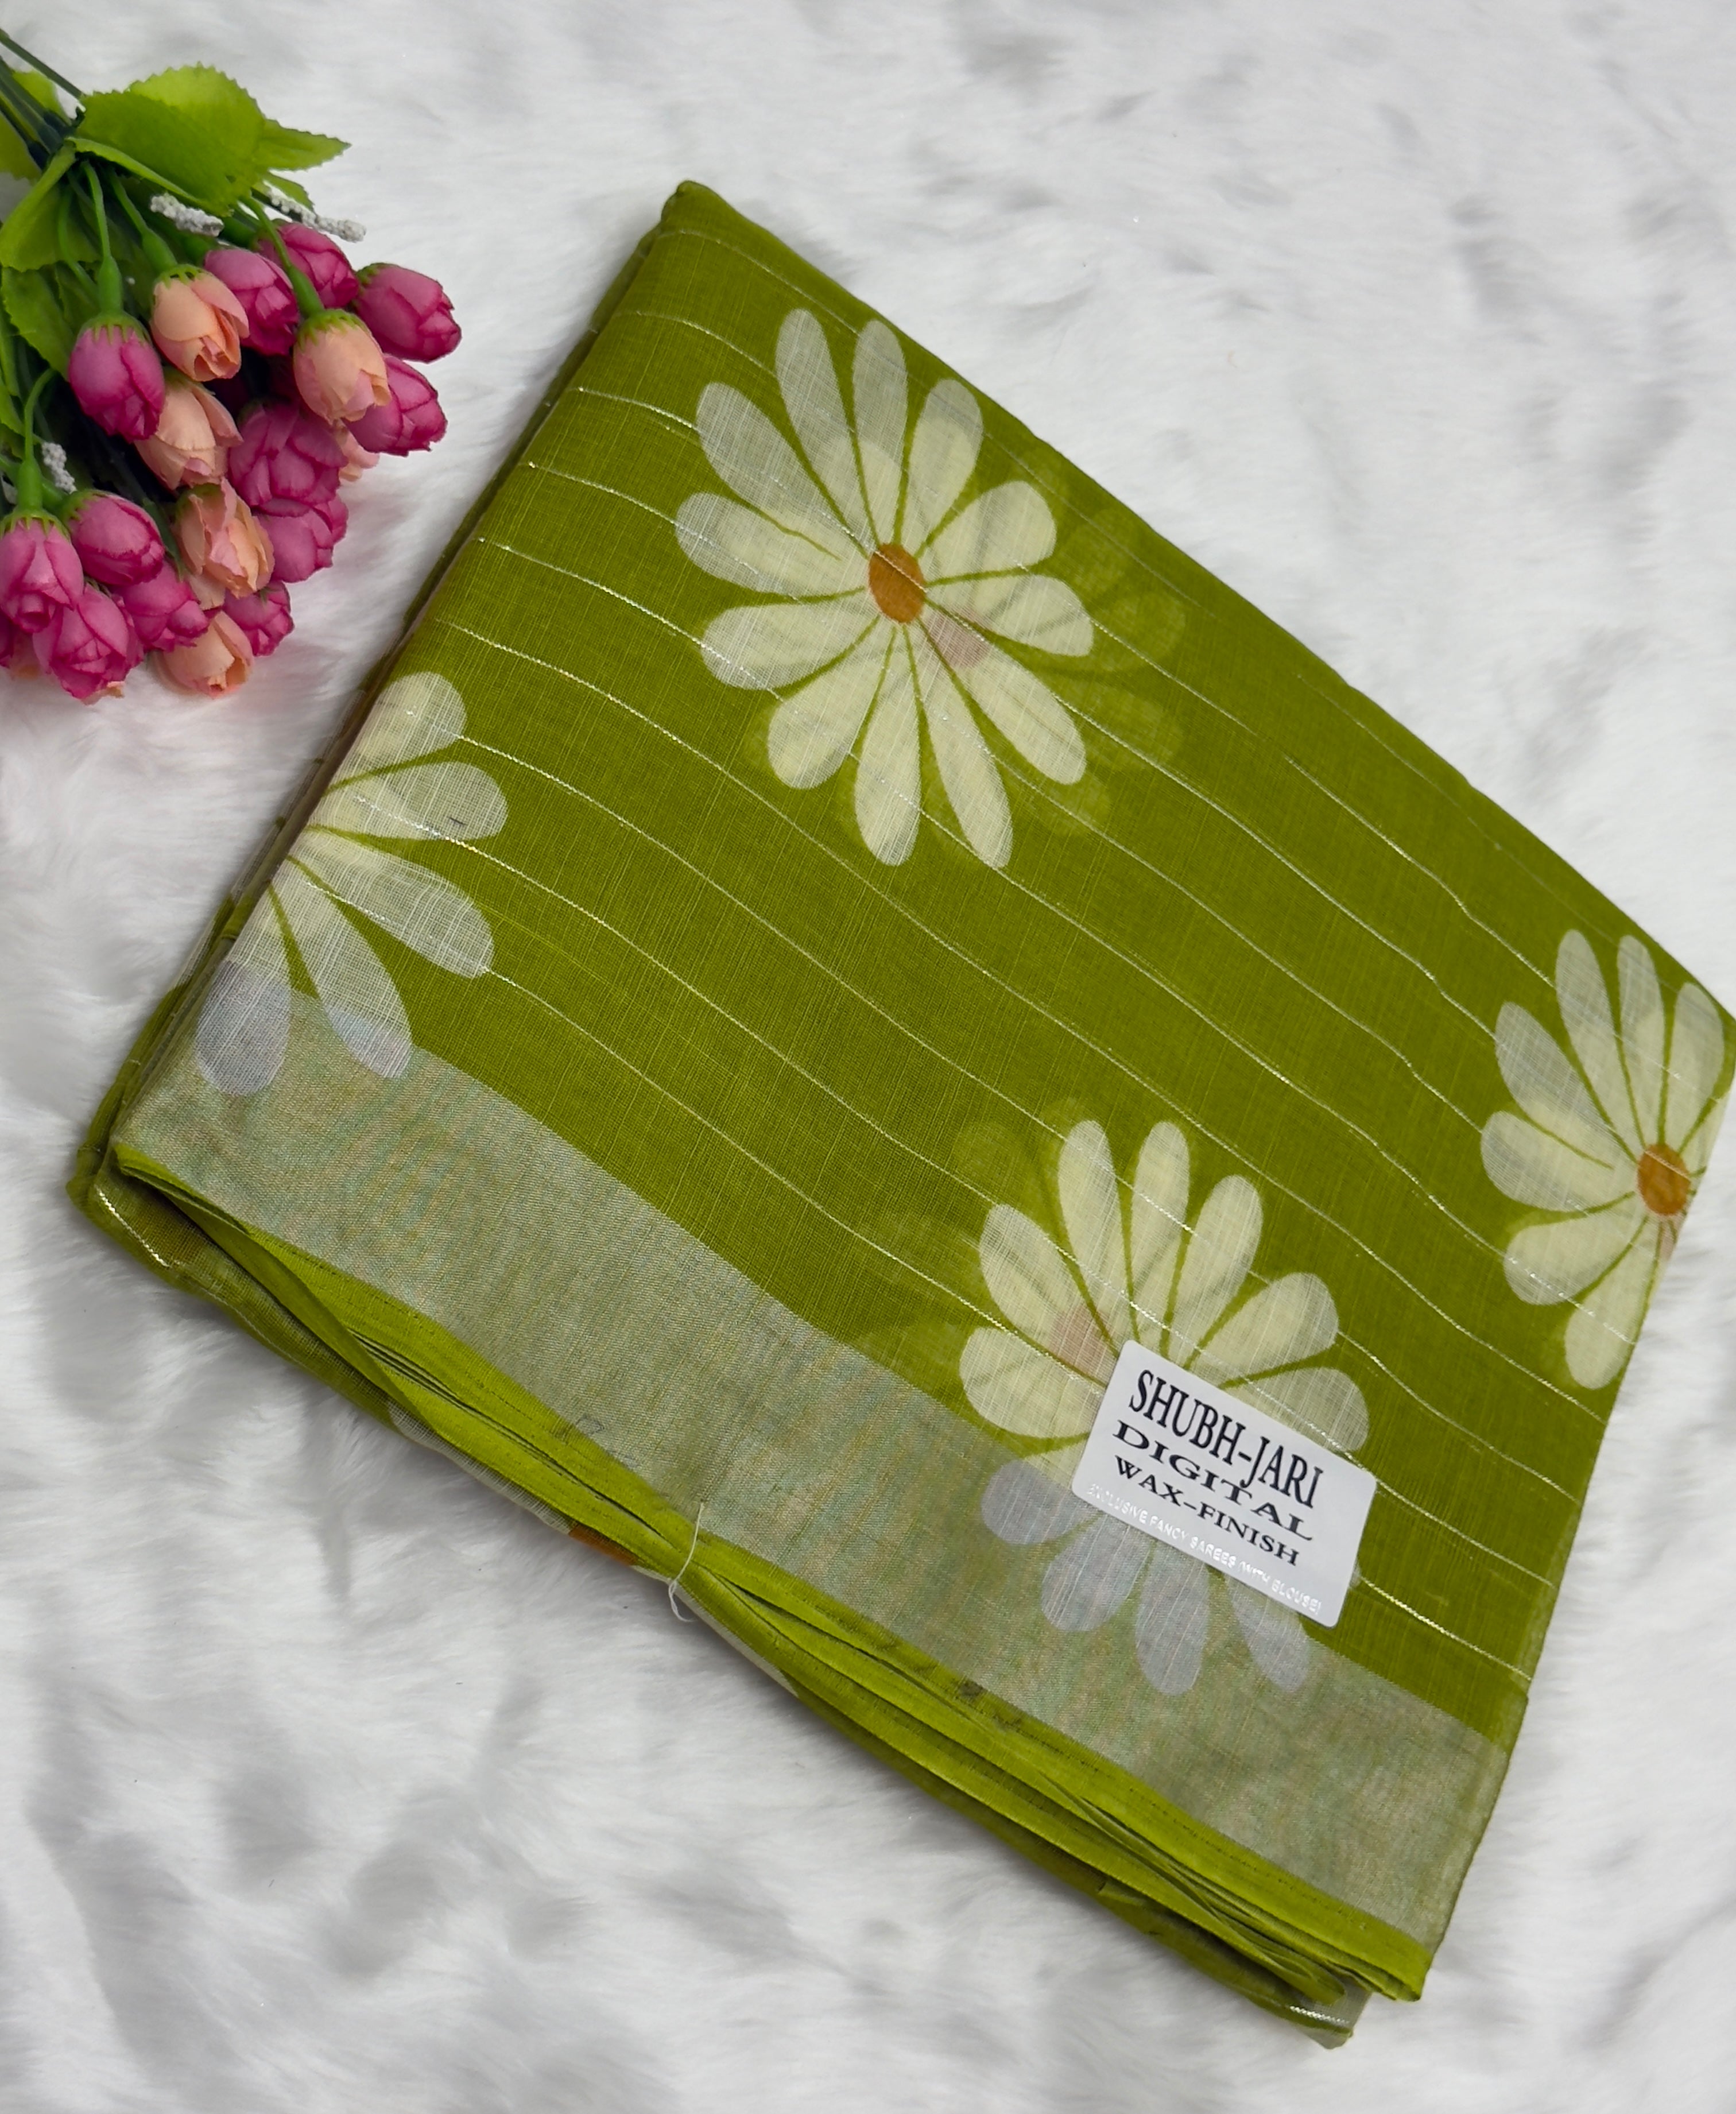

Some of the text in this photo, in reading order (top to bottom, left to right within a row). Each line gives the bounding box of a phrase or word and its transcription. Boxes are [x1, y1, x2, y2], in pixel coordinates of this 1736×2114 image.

[1112, 1419, 1313, 1542] DIGITAL
[1128, 1369, 1324, 1509] SHUBH-JARI
[1114, 1455, 1300, 1567] WAX-FINISH
[1149, 1515, 1189, 1542] FANCY
[1189, 1536, 1237, 1569] SAREES
